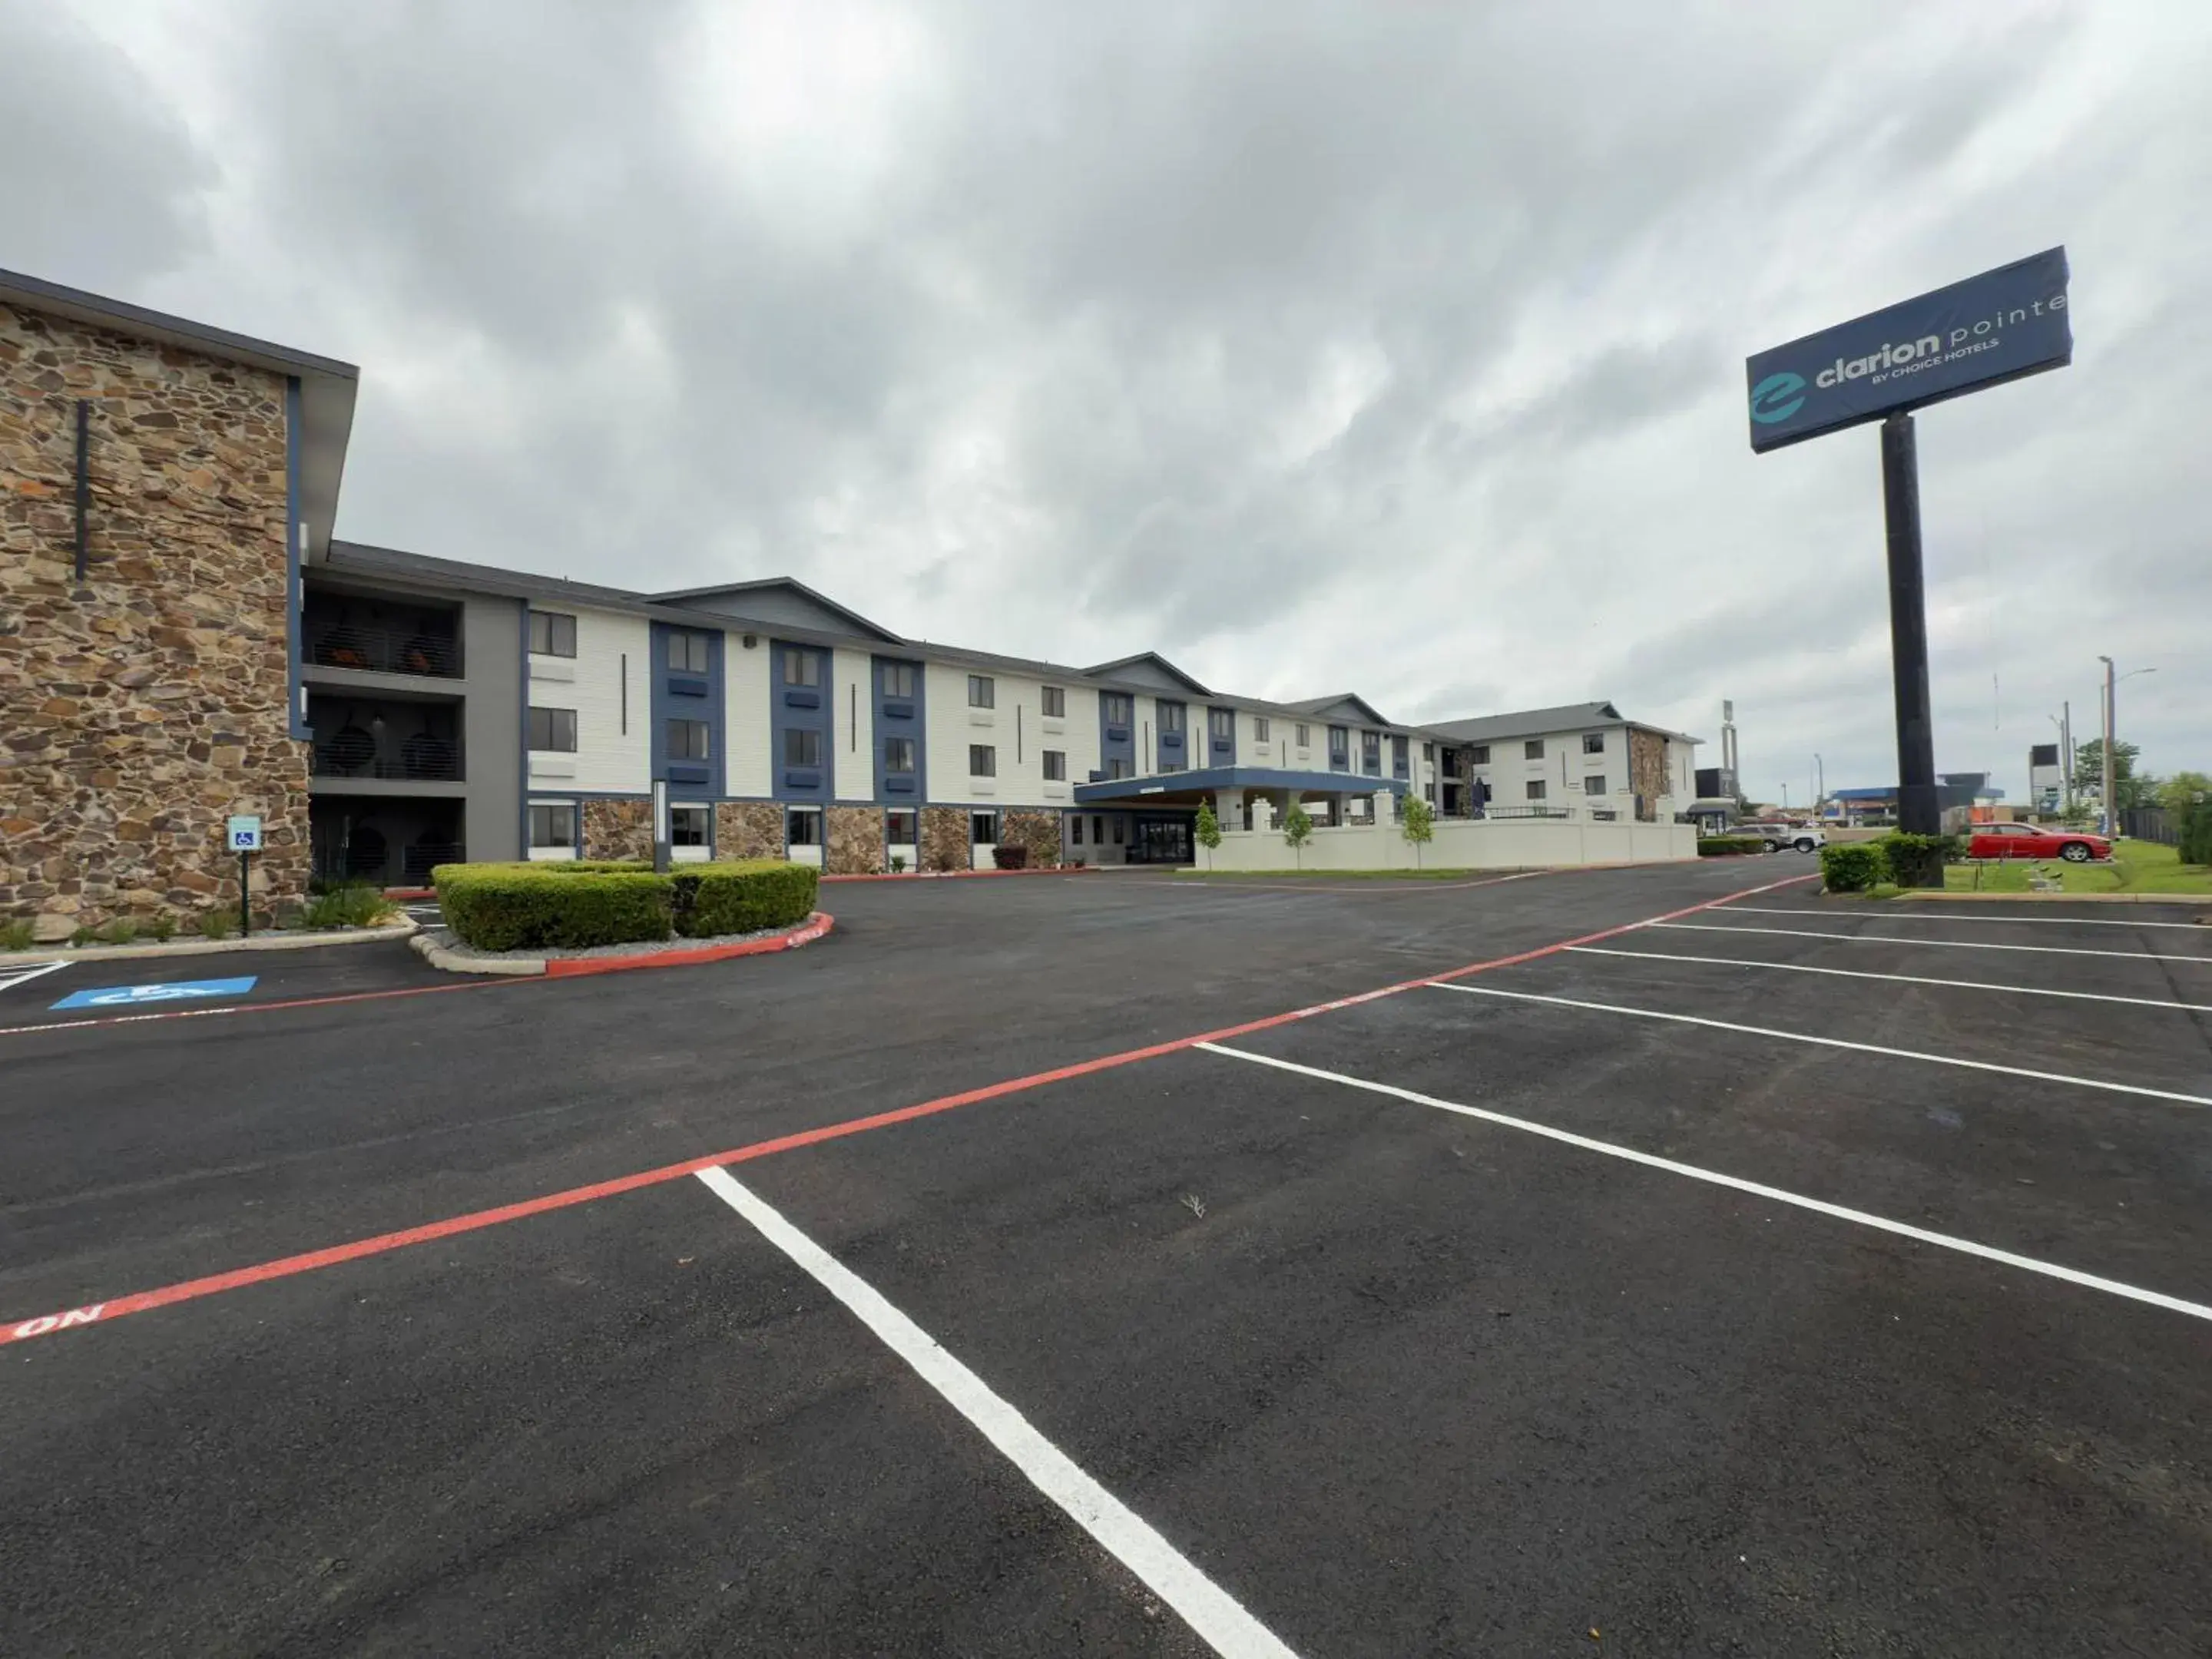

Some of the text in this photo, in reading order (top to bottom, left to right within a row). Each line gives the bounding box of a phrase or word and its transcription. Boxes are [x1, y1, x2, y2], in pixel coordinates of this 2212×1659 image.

[1816, 294, 2067, 389] clarion pointe
[1872, 337, 1999, 385] BY CHOICE HOTELS
